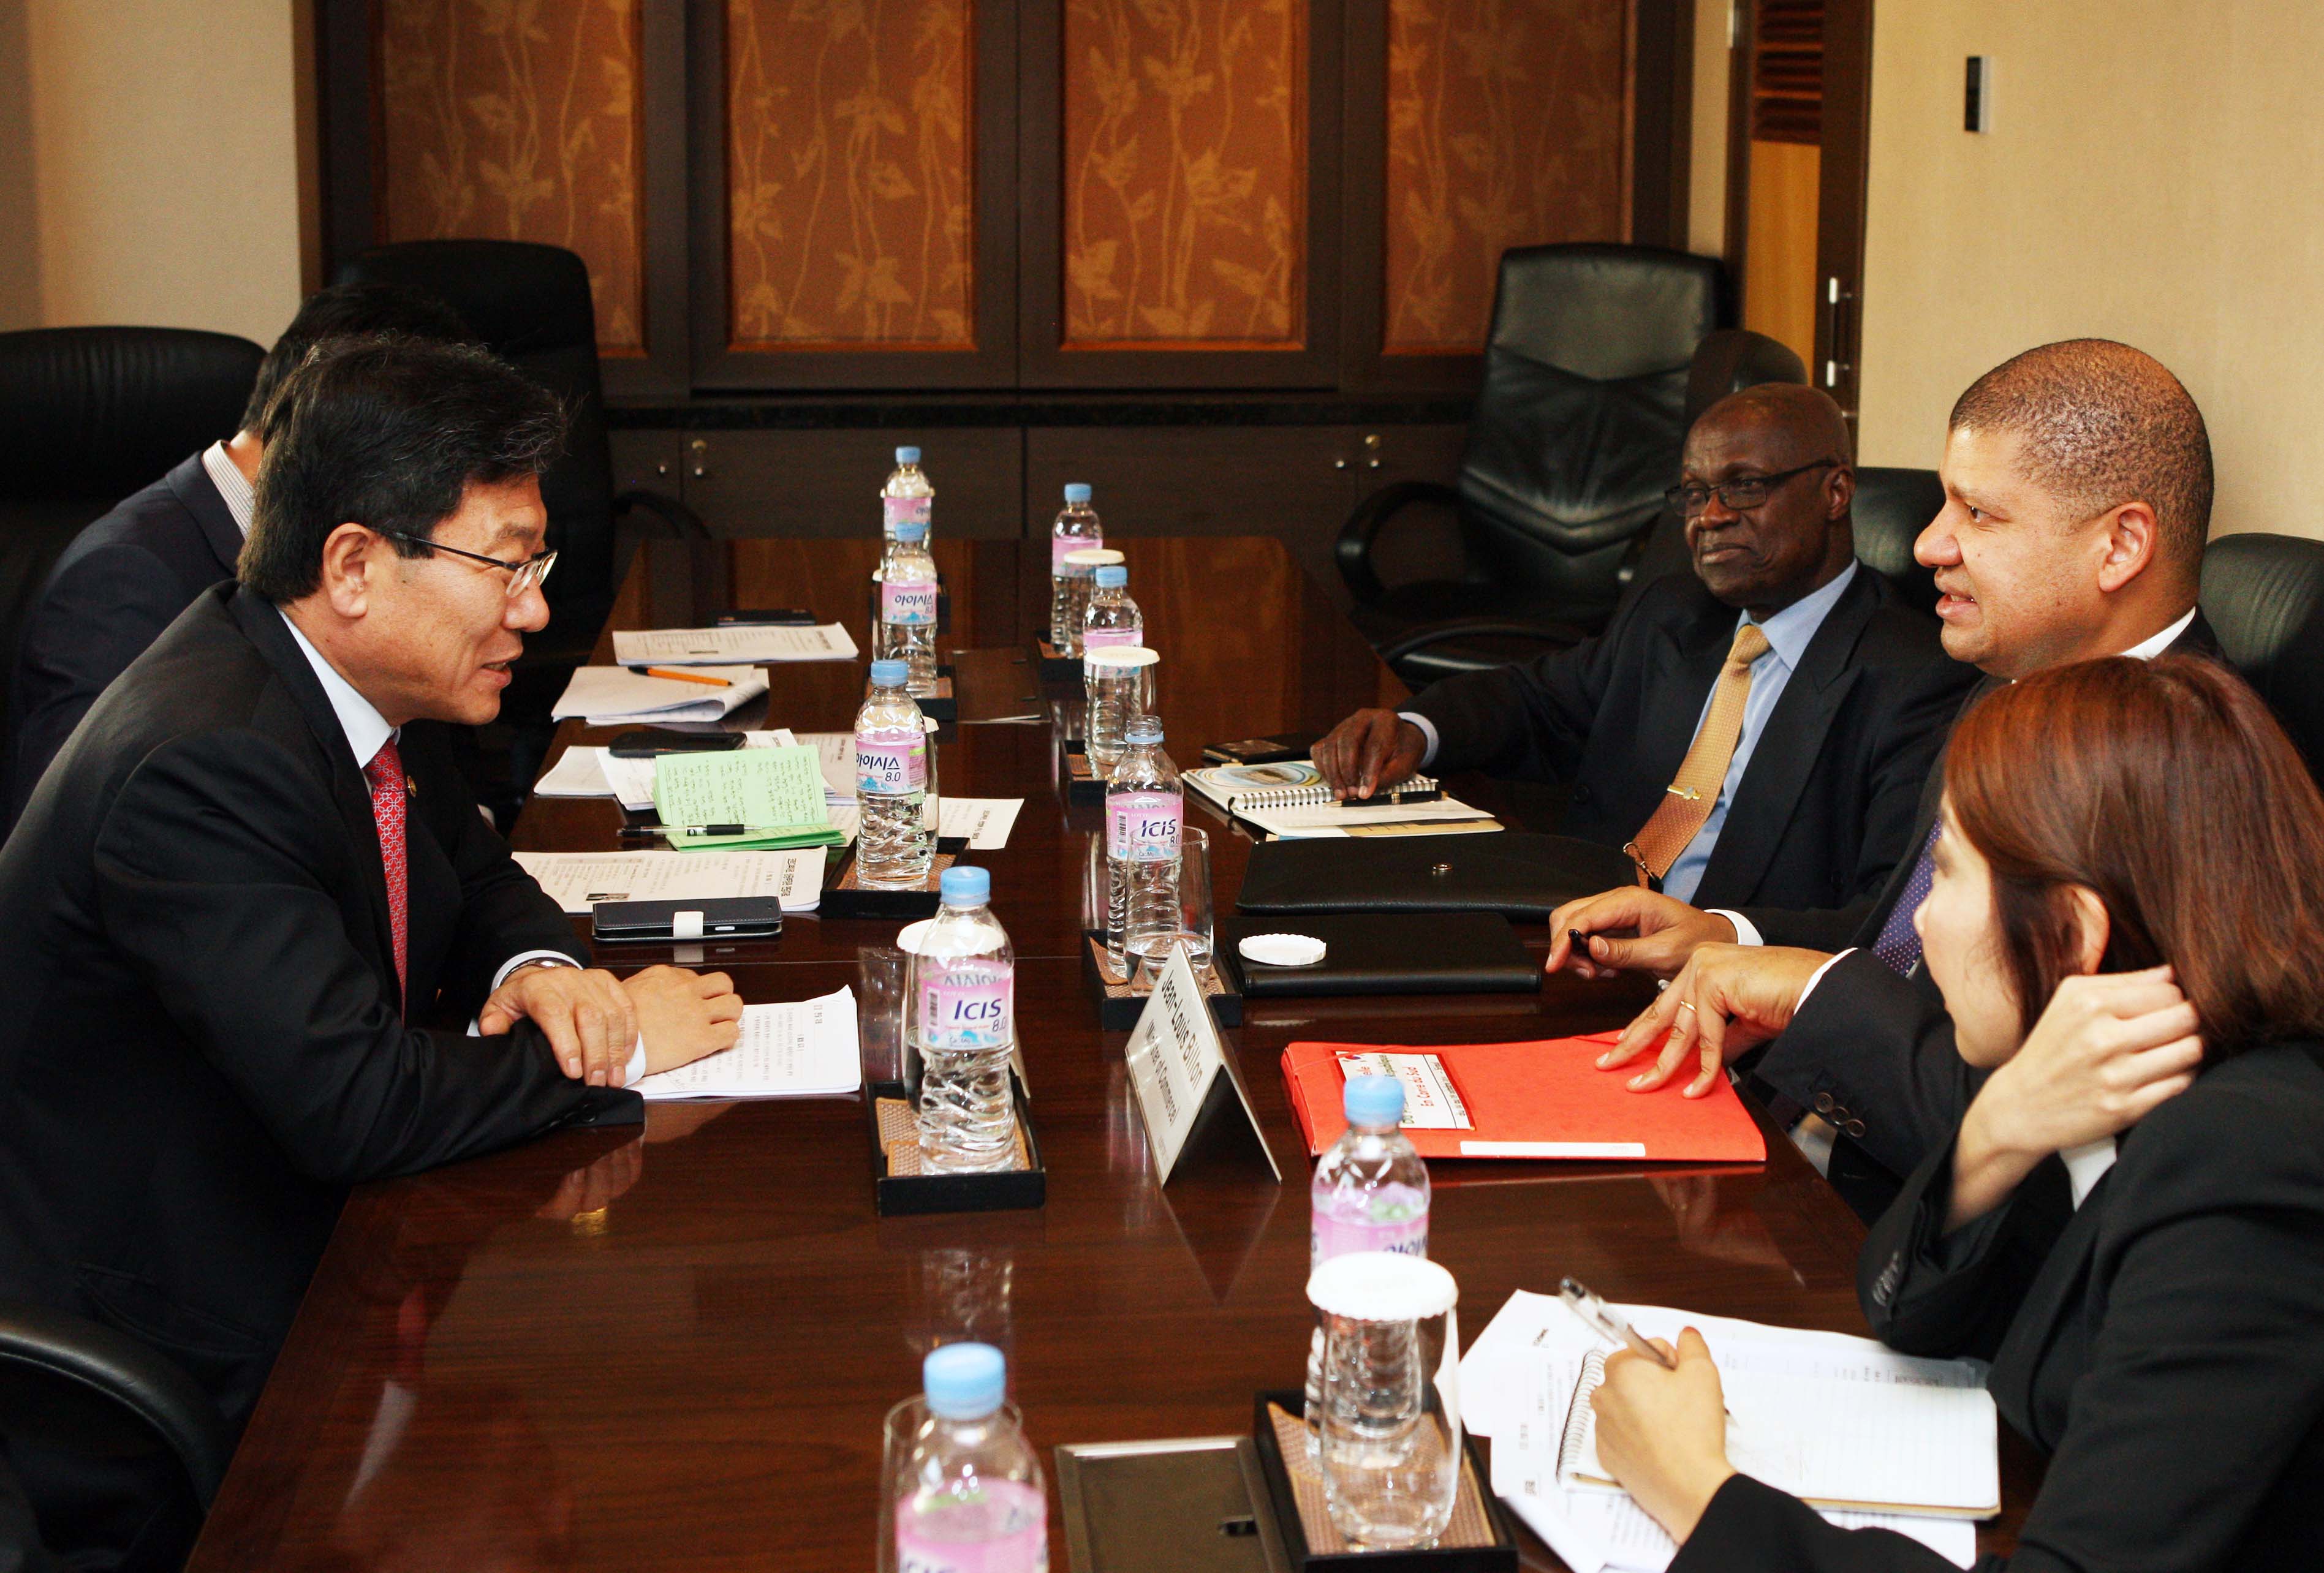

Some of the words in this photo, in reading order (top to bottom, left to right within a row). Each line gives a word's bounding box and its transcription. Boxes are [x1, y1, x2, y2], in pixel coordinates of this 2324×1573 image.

[885, 772, 901, 782] 8.0
[954, 998, 1002, 1020] ICIS
[1162, 970, 1190, 1050] Jean-Louis
[1183, 1033, 1202, 1091] Billon
[1156, 1060, 1165, 1076] of
[1159, 1066, 1180, 1126] Commerce)
